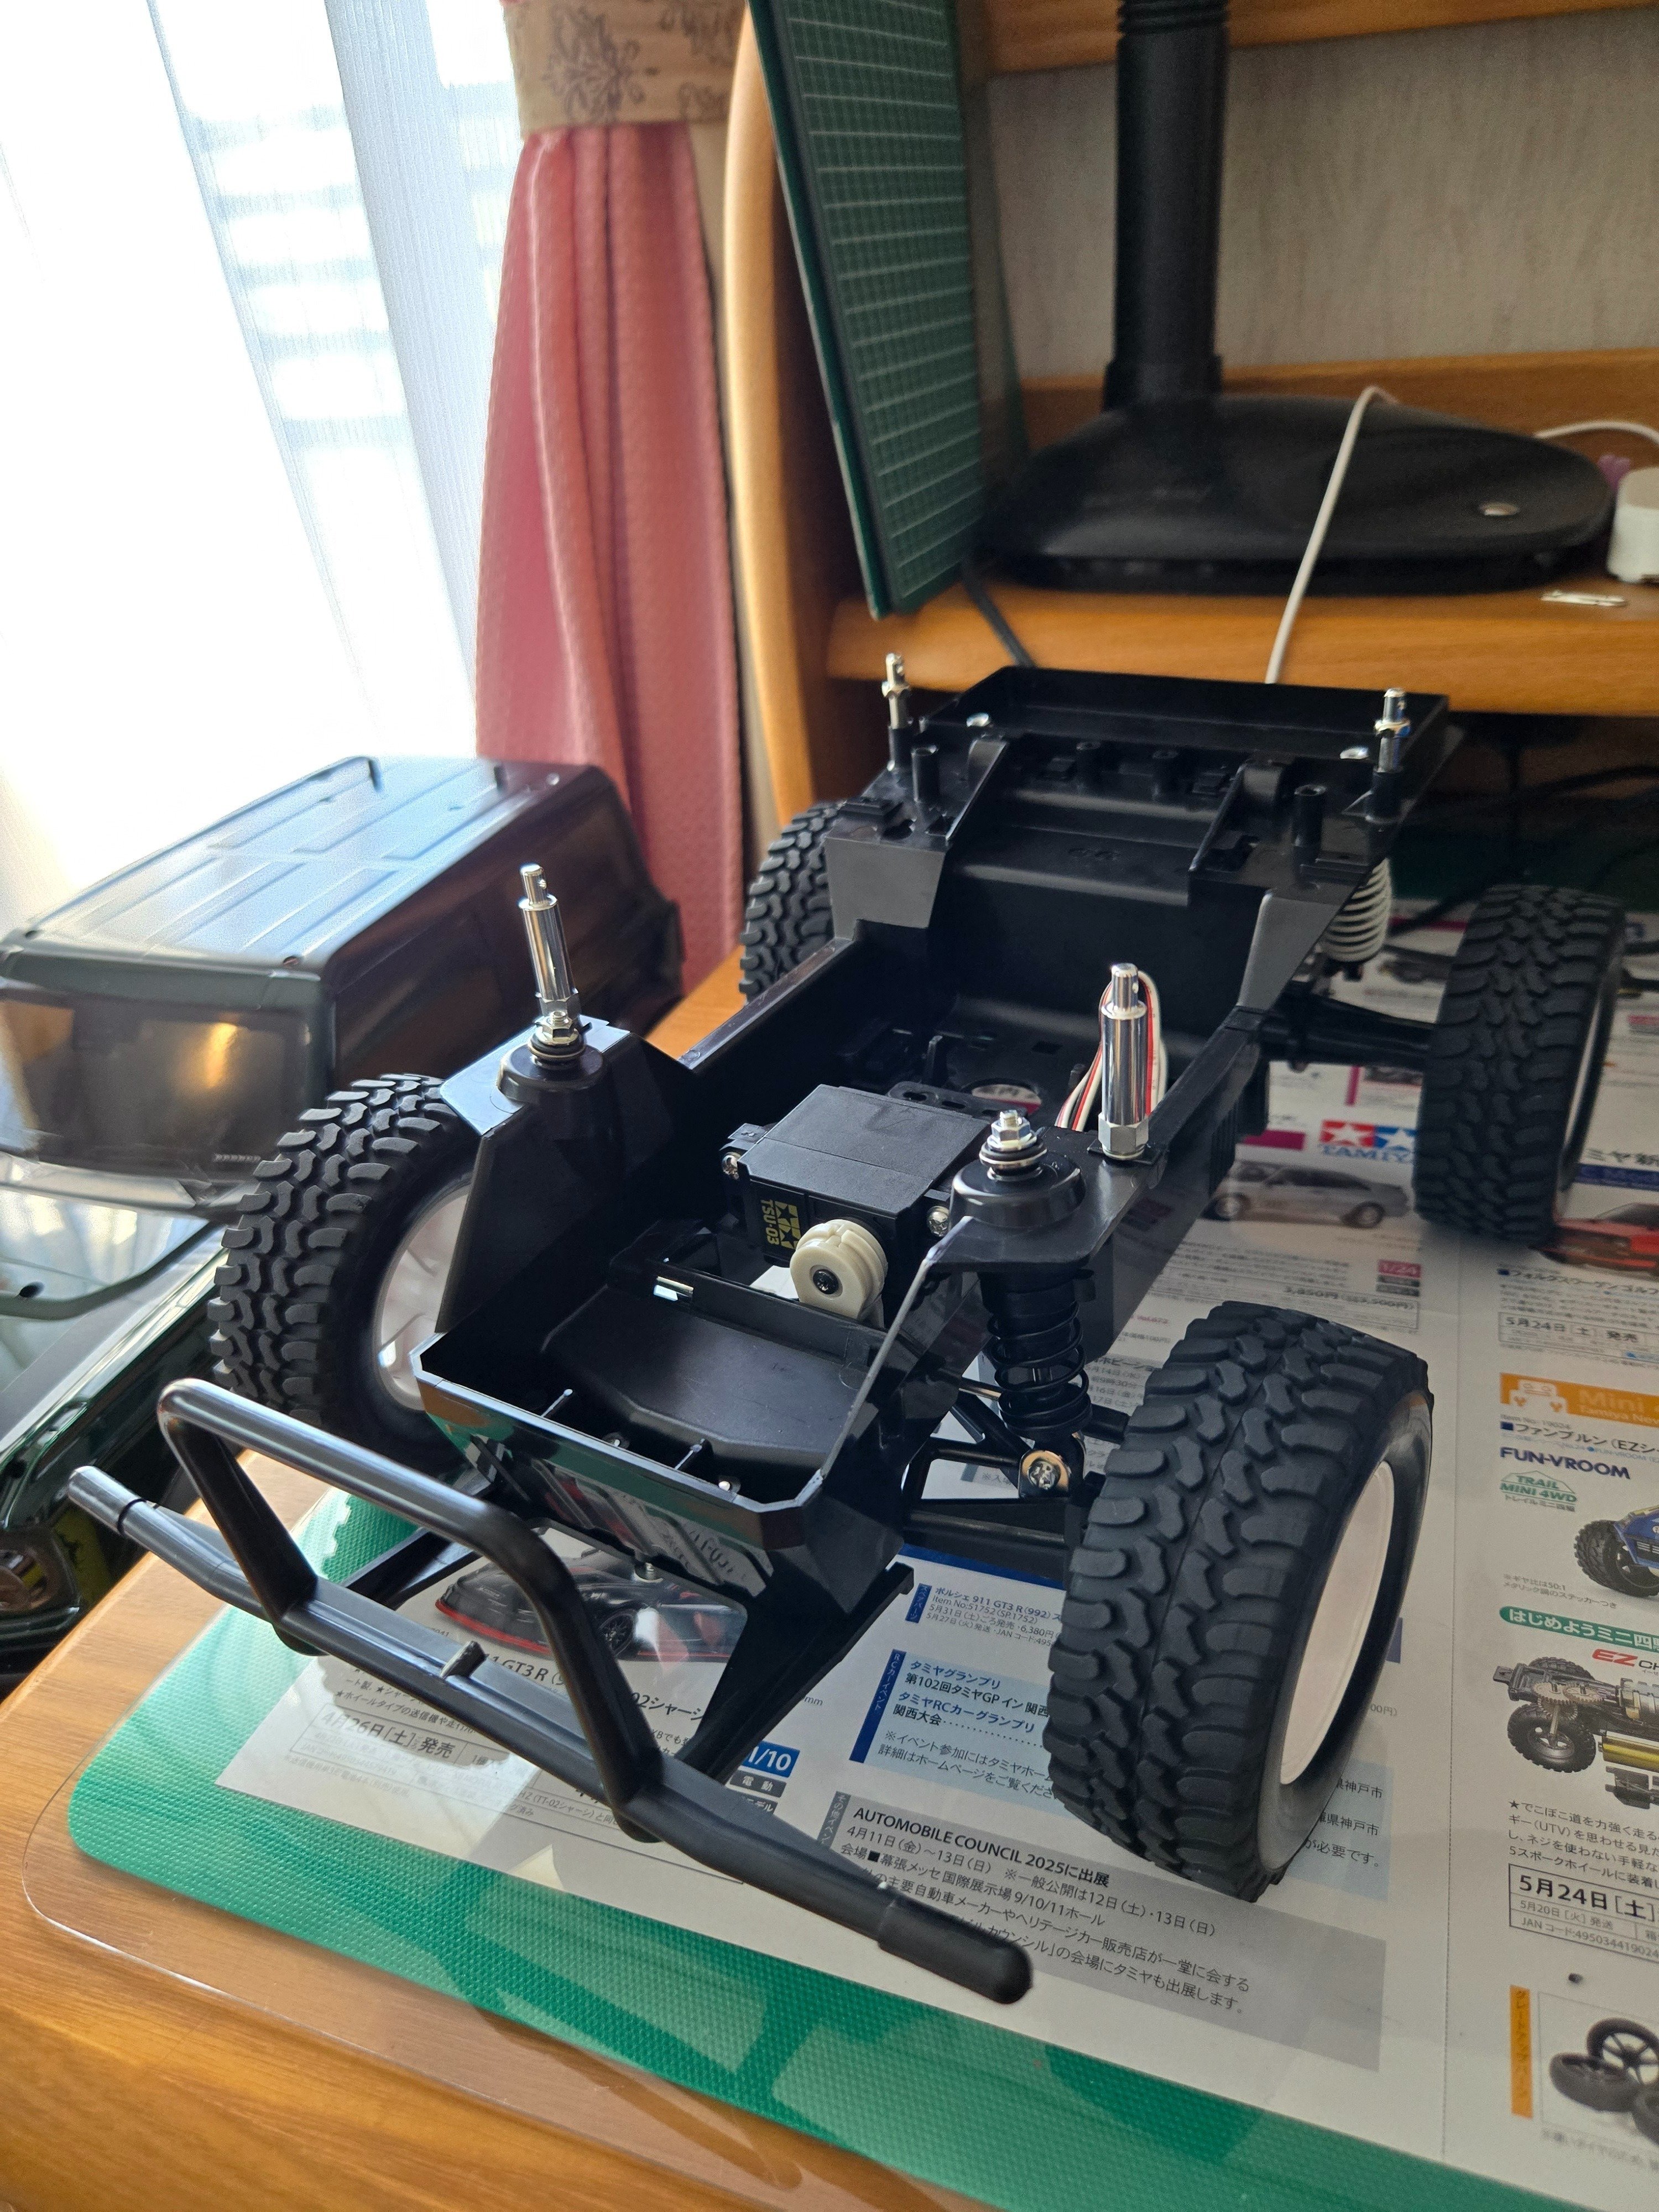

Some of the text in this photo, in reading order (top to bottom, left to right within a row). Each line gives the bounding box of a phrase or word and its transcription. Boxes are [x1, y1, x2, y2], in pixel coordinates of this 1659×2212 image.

[760, 1199, 780, 1245] TSU-03
[1500, 1446, 1631, 1480] FUN-VROOM
[1500, 1483, 1578, 1503] MINI 4WD
[1515, 1475, 1560, 1489] TRAIL
[932, 1595, 952, 1606] Item
[972, 1595, 990, 1606] 911
[993, 1600, 1014, 1611] GT3
[1592, 1648, 1639, 1667] EZ
[909, 1659, 1002, 1691] タミヤグランプリ
[898, 1690, 1035, 1734] タミヤRCカーグランプリ
[748, 1745, 792, 1771] 1/10
[878, 1743, 1053, 1799] 詳細はホームページをご覧くださ
[1508, 1799, 1659, 1841] ★でこぼこ道を力強く走る
[853, 1807, 1111, 1888] AUTOMOBILE COUNCIL 2025に出展
